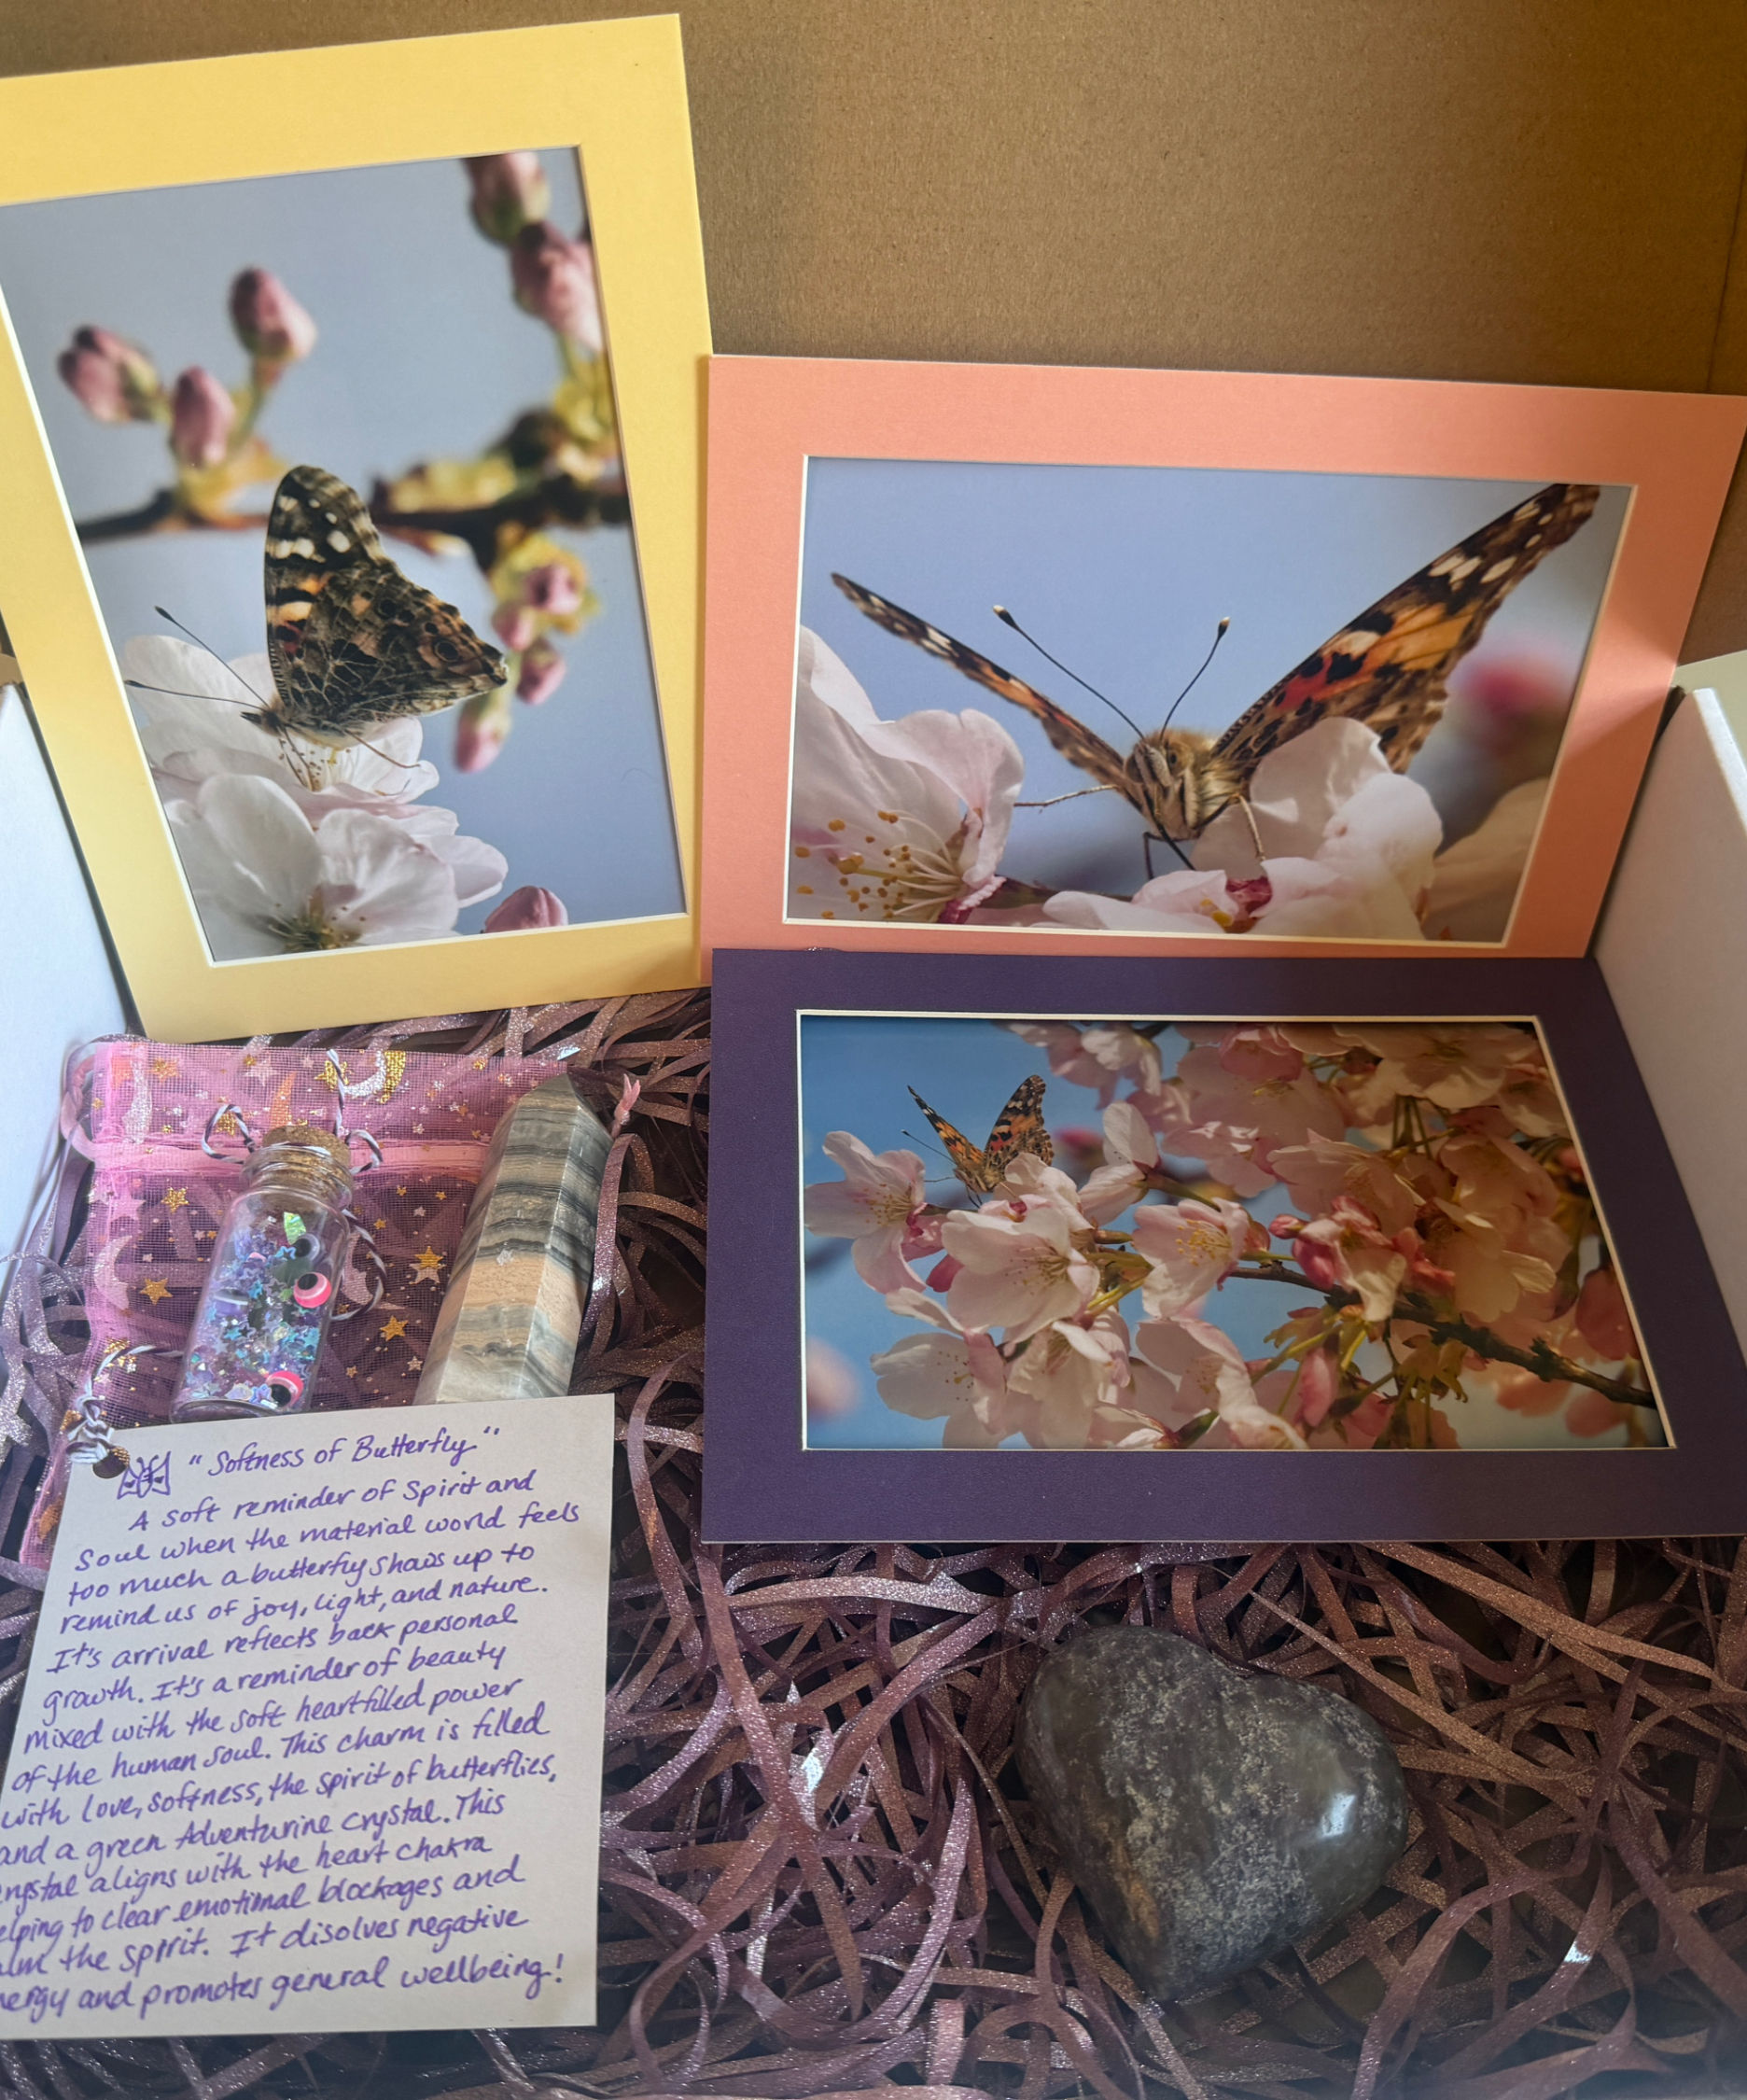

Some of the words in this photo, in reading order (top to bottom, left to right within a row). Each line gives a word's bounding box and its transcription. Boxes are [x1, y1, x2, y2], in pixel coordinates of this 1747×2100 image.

[314, 1438, 347, 1463] of
[75, 1544, 149, 1571] Soul
[161, 1537, 235, 1560] when
[245, 1527, 289, 1550] the
[300, 1514, 416, 1542] material
[425, 1505, 506, 1533] world
[519, 1502, 580, 1528] feels
[128, 1511, 149, 1531] A
[161, 1496, 220, 1527] soft
[232, 1484, 356, 1520] reminder
[361, 1479, 396, 1502] of
[486, 1469, 537, 1492] and
[60, 1603, 158, 1634] remind
[164, 1604, 196, 1622] us
[207, 1600, 239, 1619] of
[242, 1597, 308, 1626] joy,
[314, 1586, 386, 1622] light,
[391, 1579, 442, 1603] and
[449, 1575, 548, 1598] nature.
[68, 1581, 109, 1606] too
[119, 1569, 212, 1595] much
[221, 1570, 249, 1586] a
[453, 1549, 492, 1572] up
[501, 1543, 535, 1562] to
[46, 1642, 101, 1673] It's
[112, 1639, 214, 1668] arrival
[224, 1624, 319, 1655] reflects
[328, 1622, 396, 1645] back
[398, 1603, 518, 1645] personal
[23, 1718, 104, 1755] mixed
[112, 1710, 175, 1742] with
[186, 1707, 224, 1735] the
[231, 1700, 287, 1733] soft
[427, 1679, 524, 1715] power
[42, 1676, 144, 1727] growth.
[151, 1674, 204, 1701] It's
[213, 1676, 232, 1693] a
[238, 1656, 361, 1690] reminder
[363, 1647, 400, 1676] of
[408, 1640, 507, 1670] beauty
[11, 1765, 47, 1793] of
[47, 1761, 103, 1791] the
[111, 1751, 196, 1778] human
[203, 1736, 271, 1768] soul.
[281, 1730, 328, 1758] This
[337, 1727, 425, 1753] charm
[437, 1718, 459, 1741] is
[472, 1701, 551, 1740] filled
[1, 1797, 70, 1829] with
[81, 1794, 142, 1823] love,
[147, 1780, 263, 1812] softness,
[269, 1771, 309, 1801] the
[315, 1761, 390, 1799] spirit
[391, 1759, 423, 1787] of
[426, 1749, 556, 1783] butterflies,
[0, 1835, 46, 1866] and
[55, 1843, 78, 1860] a
[87, 1834, 166, 1877] green
[175, 1813, 333, 1850] Adventurine
[342, 1797, 451, 1841] crystal.
[455, 1787, 506, 1819] This
[0, 1870, 78, 1916] rystal
[89, 1865, 177, 1905] aligns
[187, 1852, 251, 1884] with
[259, 1849, 310, 1878] the
[315, 1841, 389, 1869] heart
[396, 1836, 493, 1862] chakra
[0, 1905, 63, 1956] elping
[71, 1906, 94, 1938] to
[101, 1902, 171, 1930] clear
[317, 1875, 443, 1911] blockages
[454, 1854, 525, 1891] and
[0, 1939, 49, 1978] lm
[59, 1942, 110, 1972] the
[119, 1927, 209, 1978] spirit.
[230, 1921, 276, 1958] It
[280, 1915, 399, 1950] disolves
[407, 1905, 529, 1953] negative
[0, 1985, 70, 2023] ergy
[78, 1981, 135, 2010] and
[140, 1971, 263, 2020] promotes
[271, 1955, 390, 2011] general
[400, 1953, 564, 2000] wellbeing!
